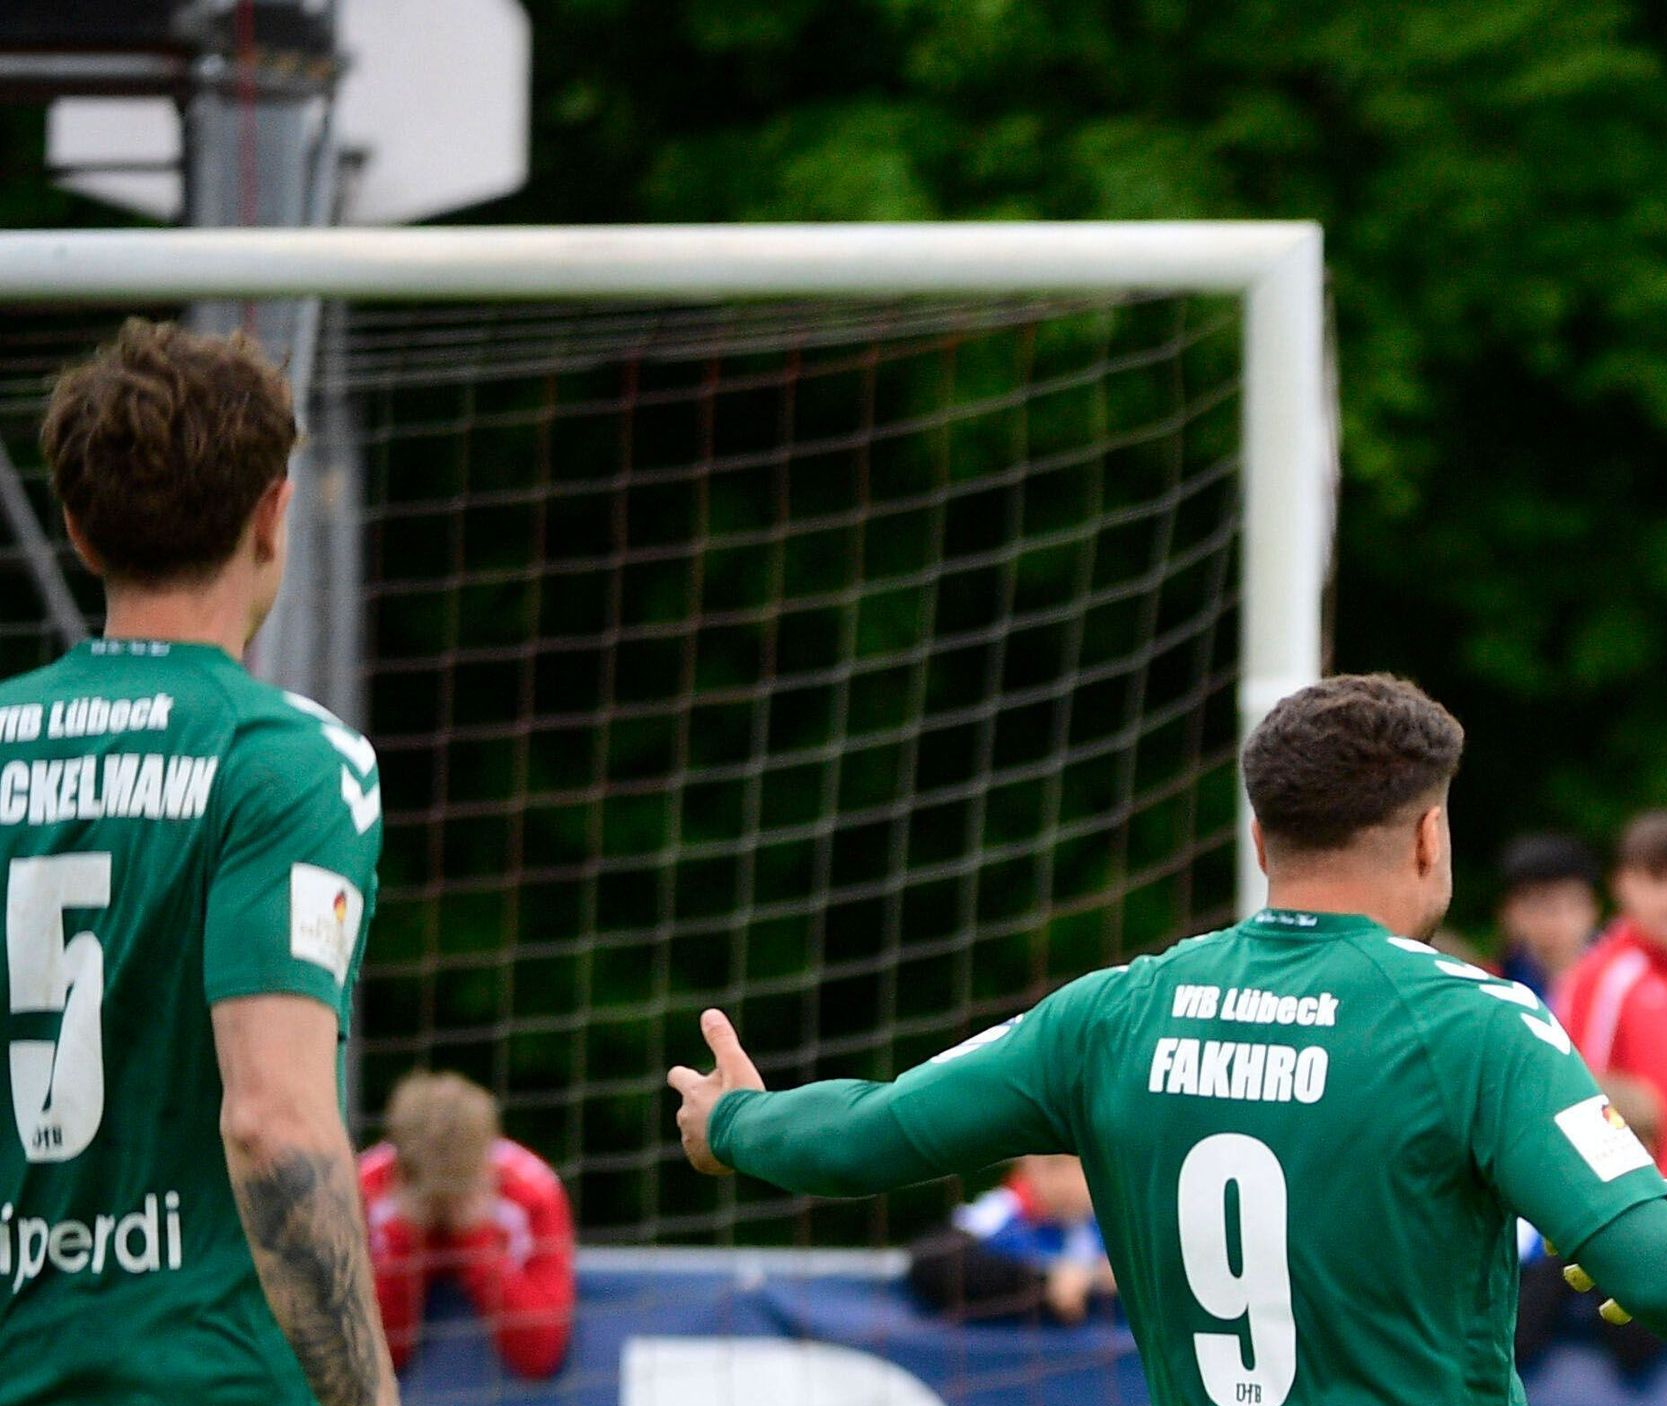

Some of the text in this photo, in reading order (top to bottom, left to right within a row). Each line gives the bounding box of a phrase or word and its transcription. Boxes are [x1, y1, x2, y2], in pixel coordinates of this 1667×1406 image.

[7, 851, 112, 1163] 5
[1172, 984, 1339, 1027] VfB Lübeck
[1148, 1037, 1329, 1104] FAKHRO
